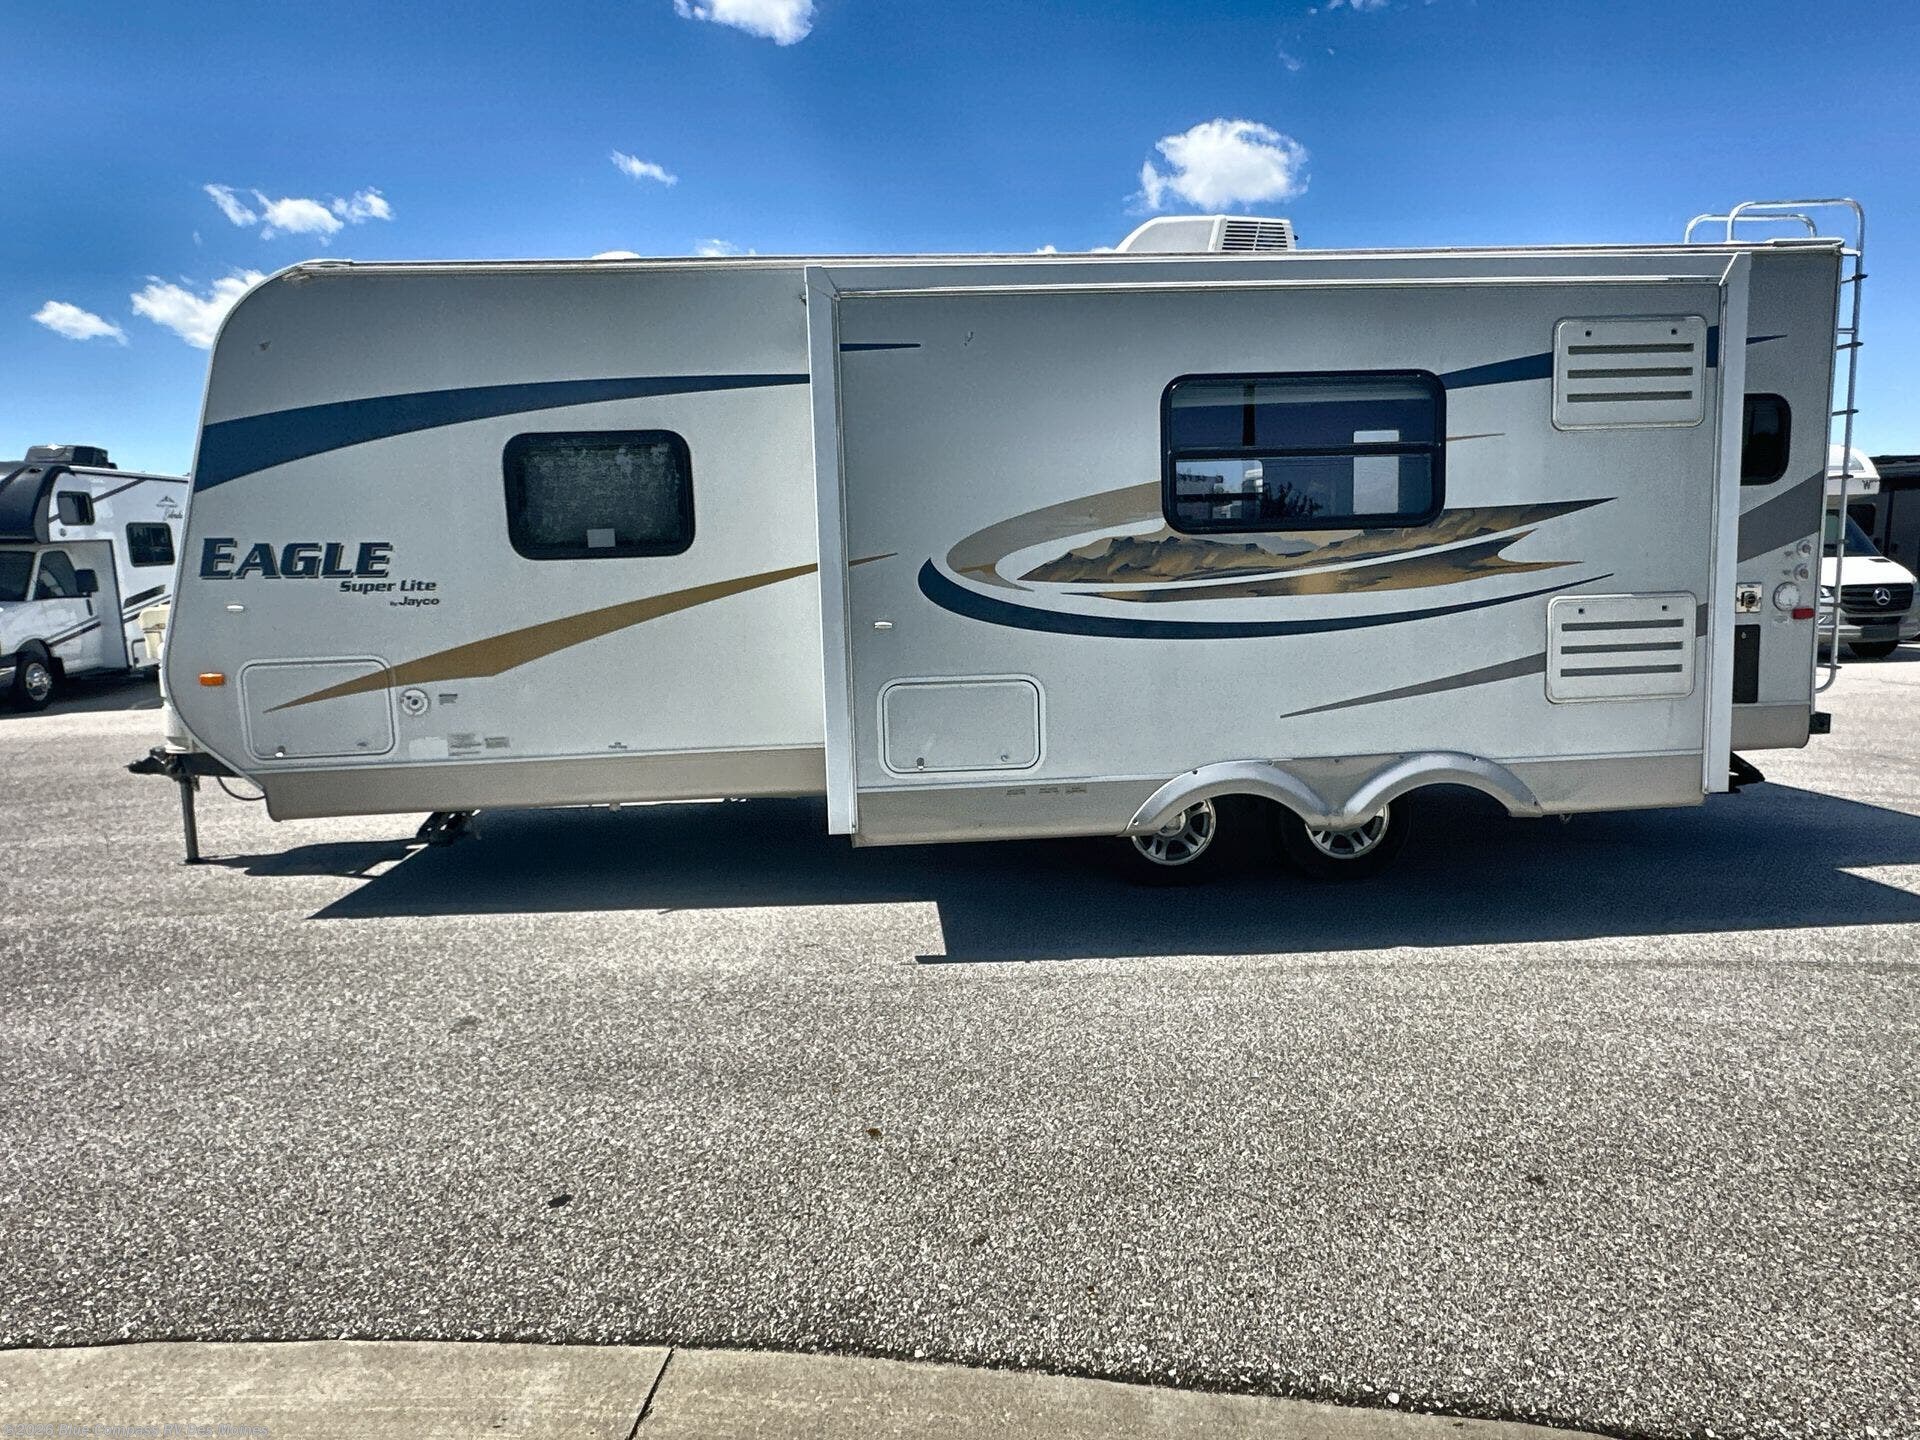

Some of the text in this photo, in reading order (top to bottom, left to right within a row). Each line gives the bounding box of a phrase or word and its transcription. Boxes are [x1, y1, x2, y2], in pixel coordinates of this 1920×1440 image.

[199, 537, 393, 580] EAGLE
[339, 579, 437, 595] Super Lite
[399, 596, 440, 608] Jayco
